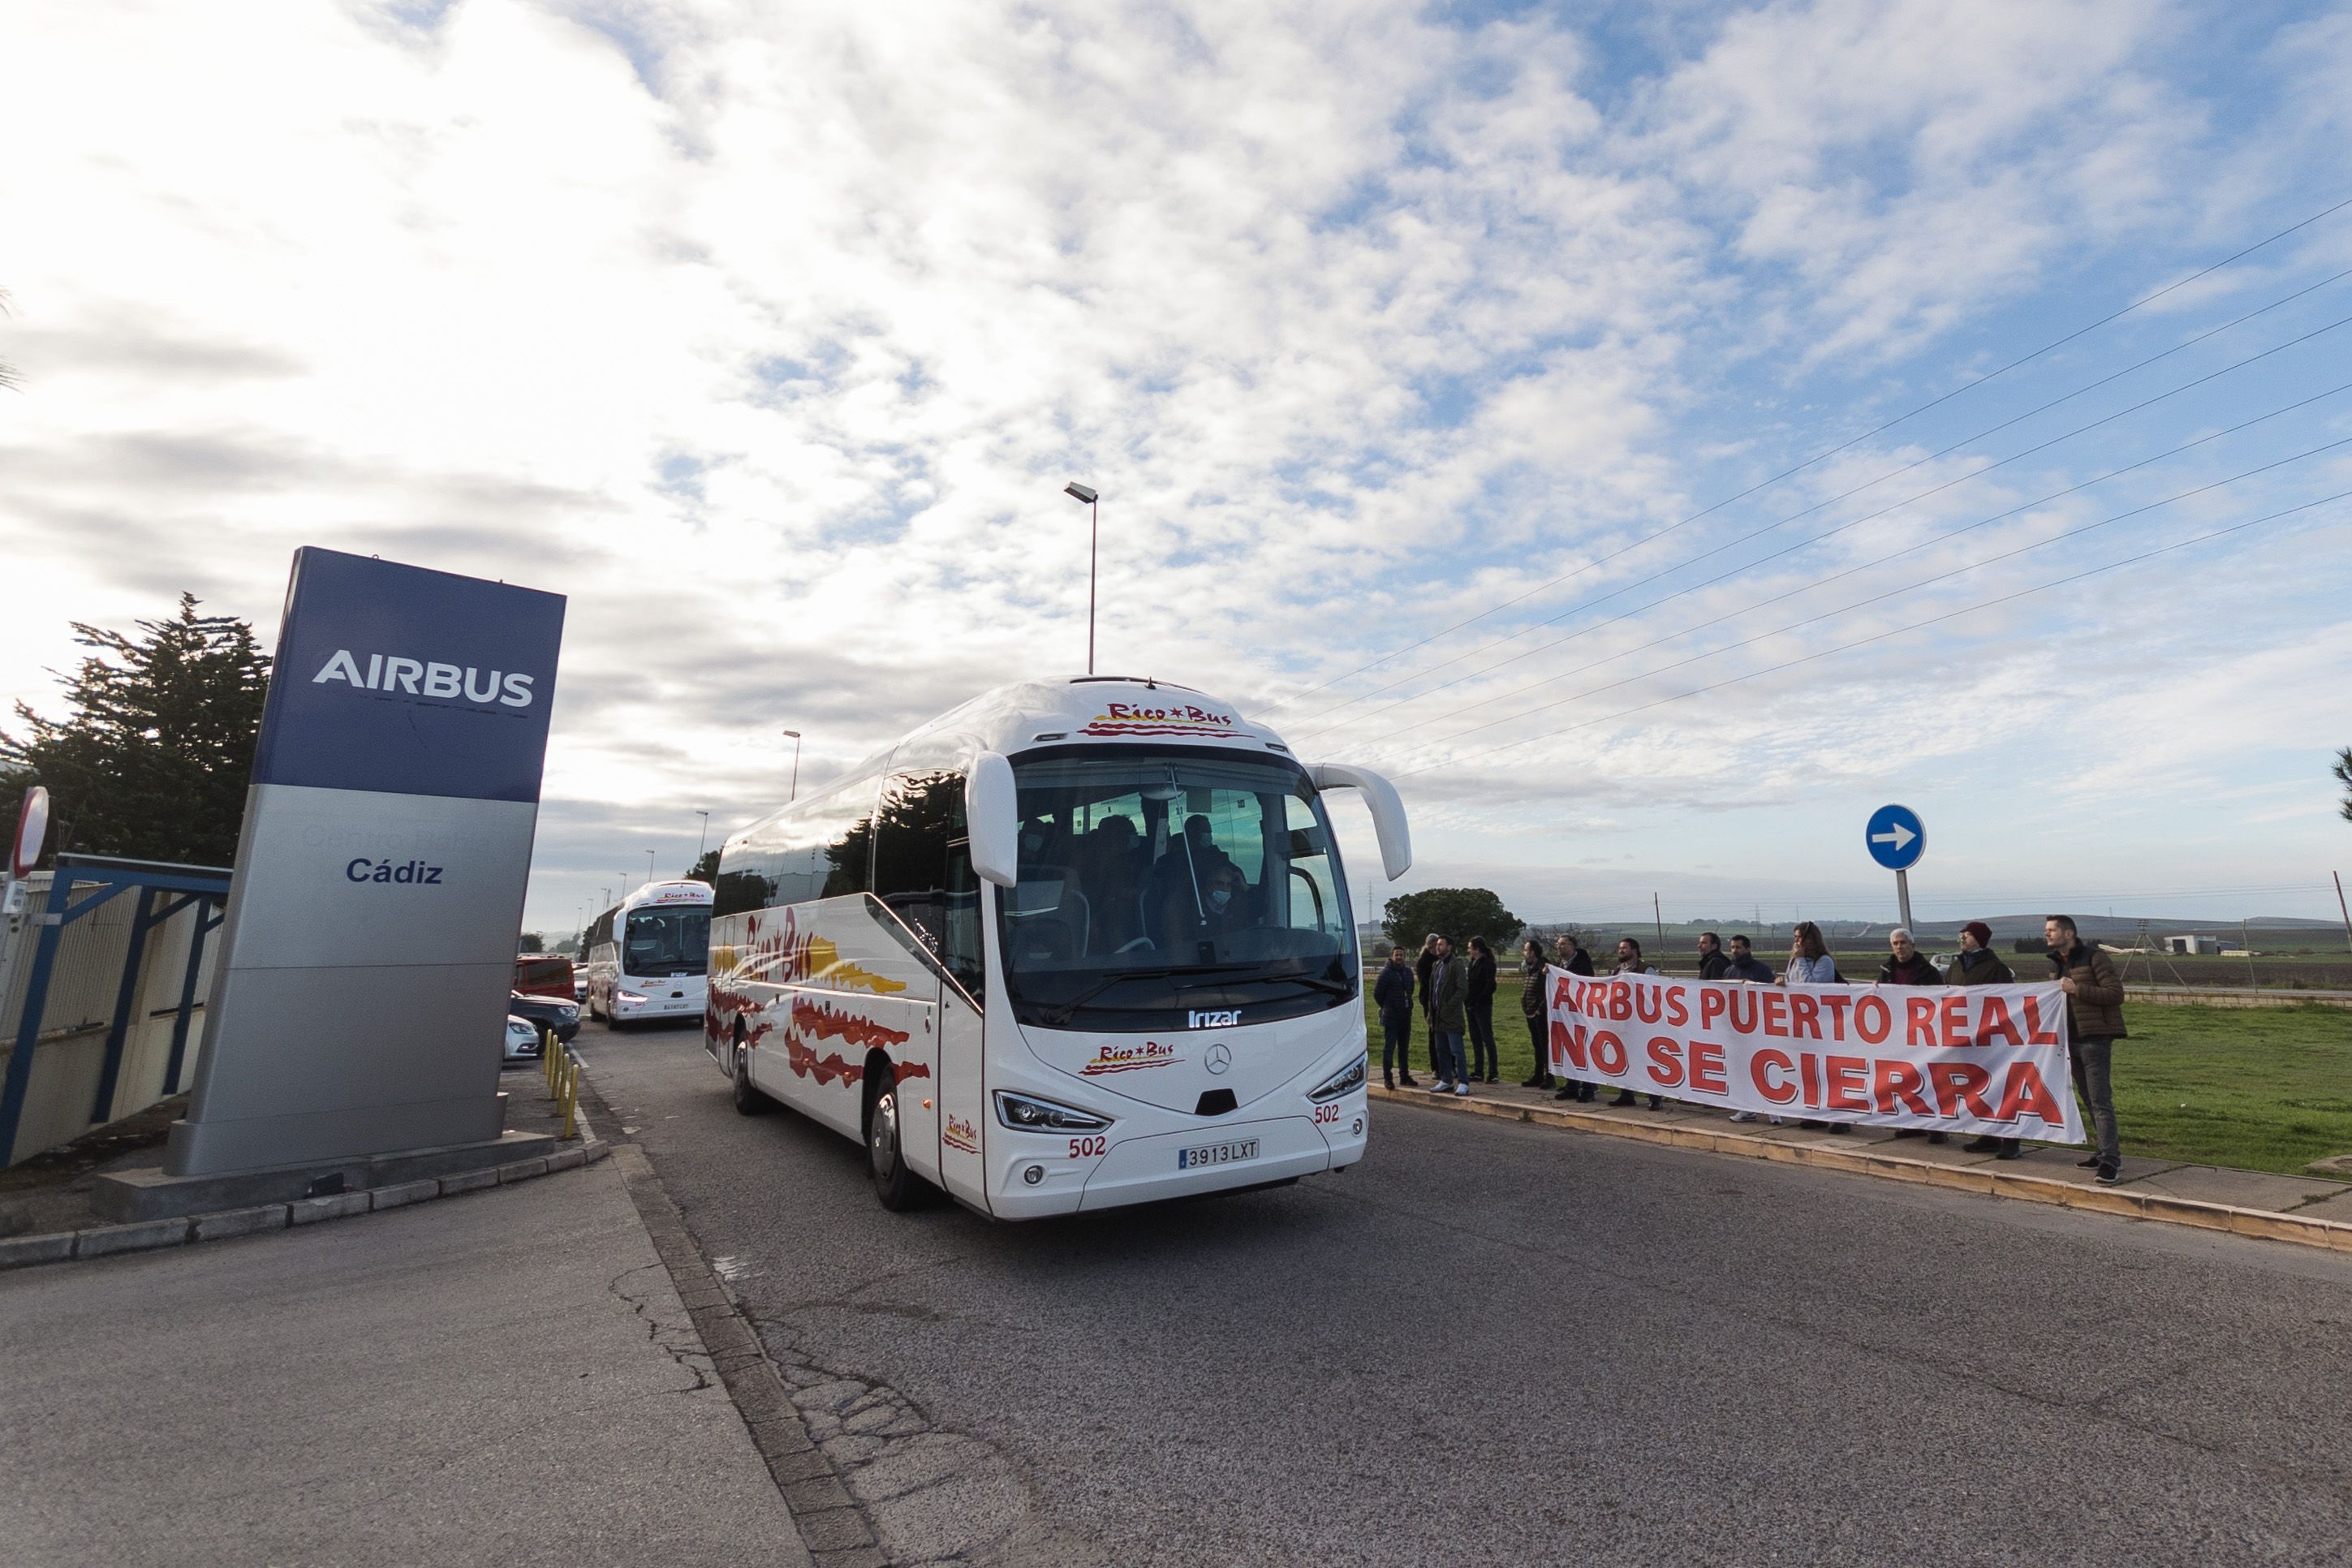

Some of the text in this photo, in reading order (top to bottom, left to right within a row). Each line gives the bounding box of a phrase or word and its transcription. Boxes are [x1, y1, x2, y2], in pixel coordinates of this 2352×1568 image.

[312, 649, 535, 708] AIRBUS
[1107, 703, 1232, 726] Rico Bus
[347, 858, 444, 885] Cádiz
[1188, 1010, 1242, 1028] Irizar
[1552, 976, 2059, 1047] AIRBUS PUERTO REAL
[1100, 1041, 1174, 1062] Rico Bus
[1551, 1020, 2065, 1126] NO SE CIERRA
[1315, 1104, 1339, 1124] 502
[1069, 1136, 1107, 1159] 502
